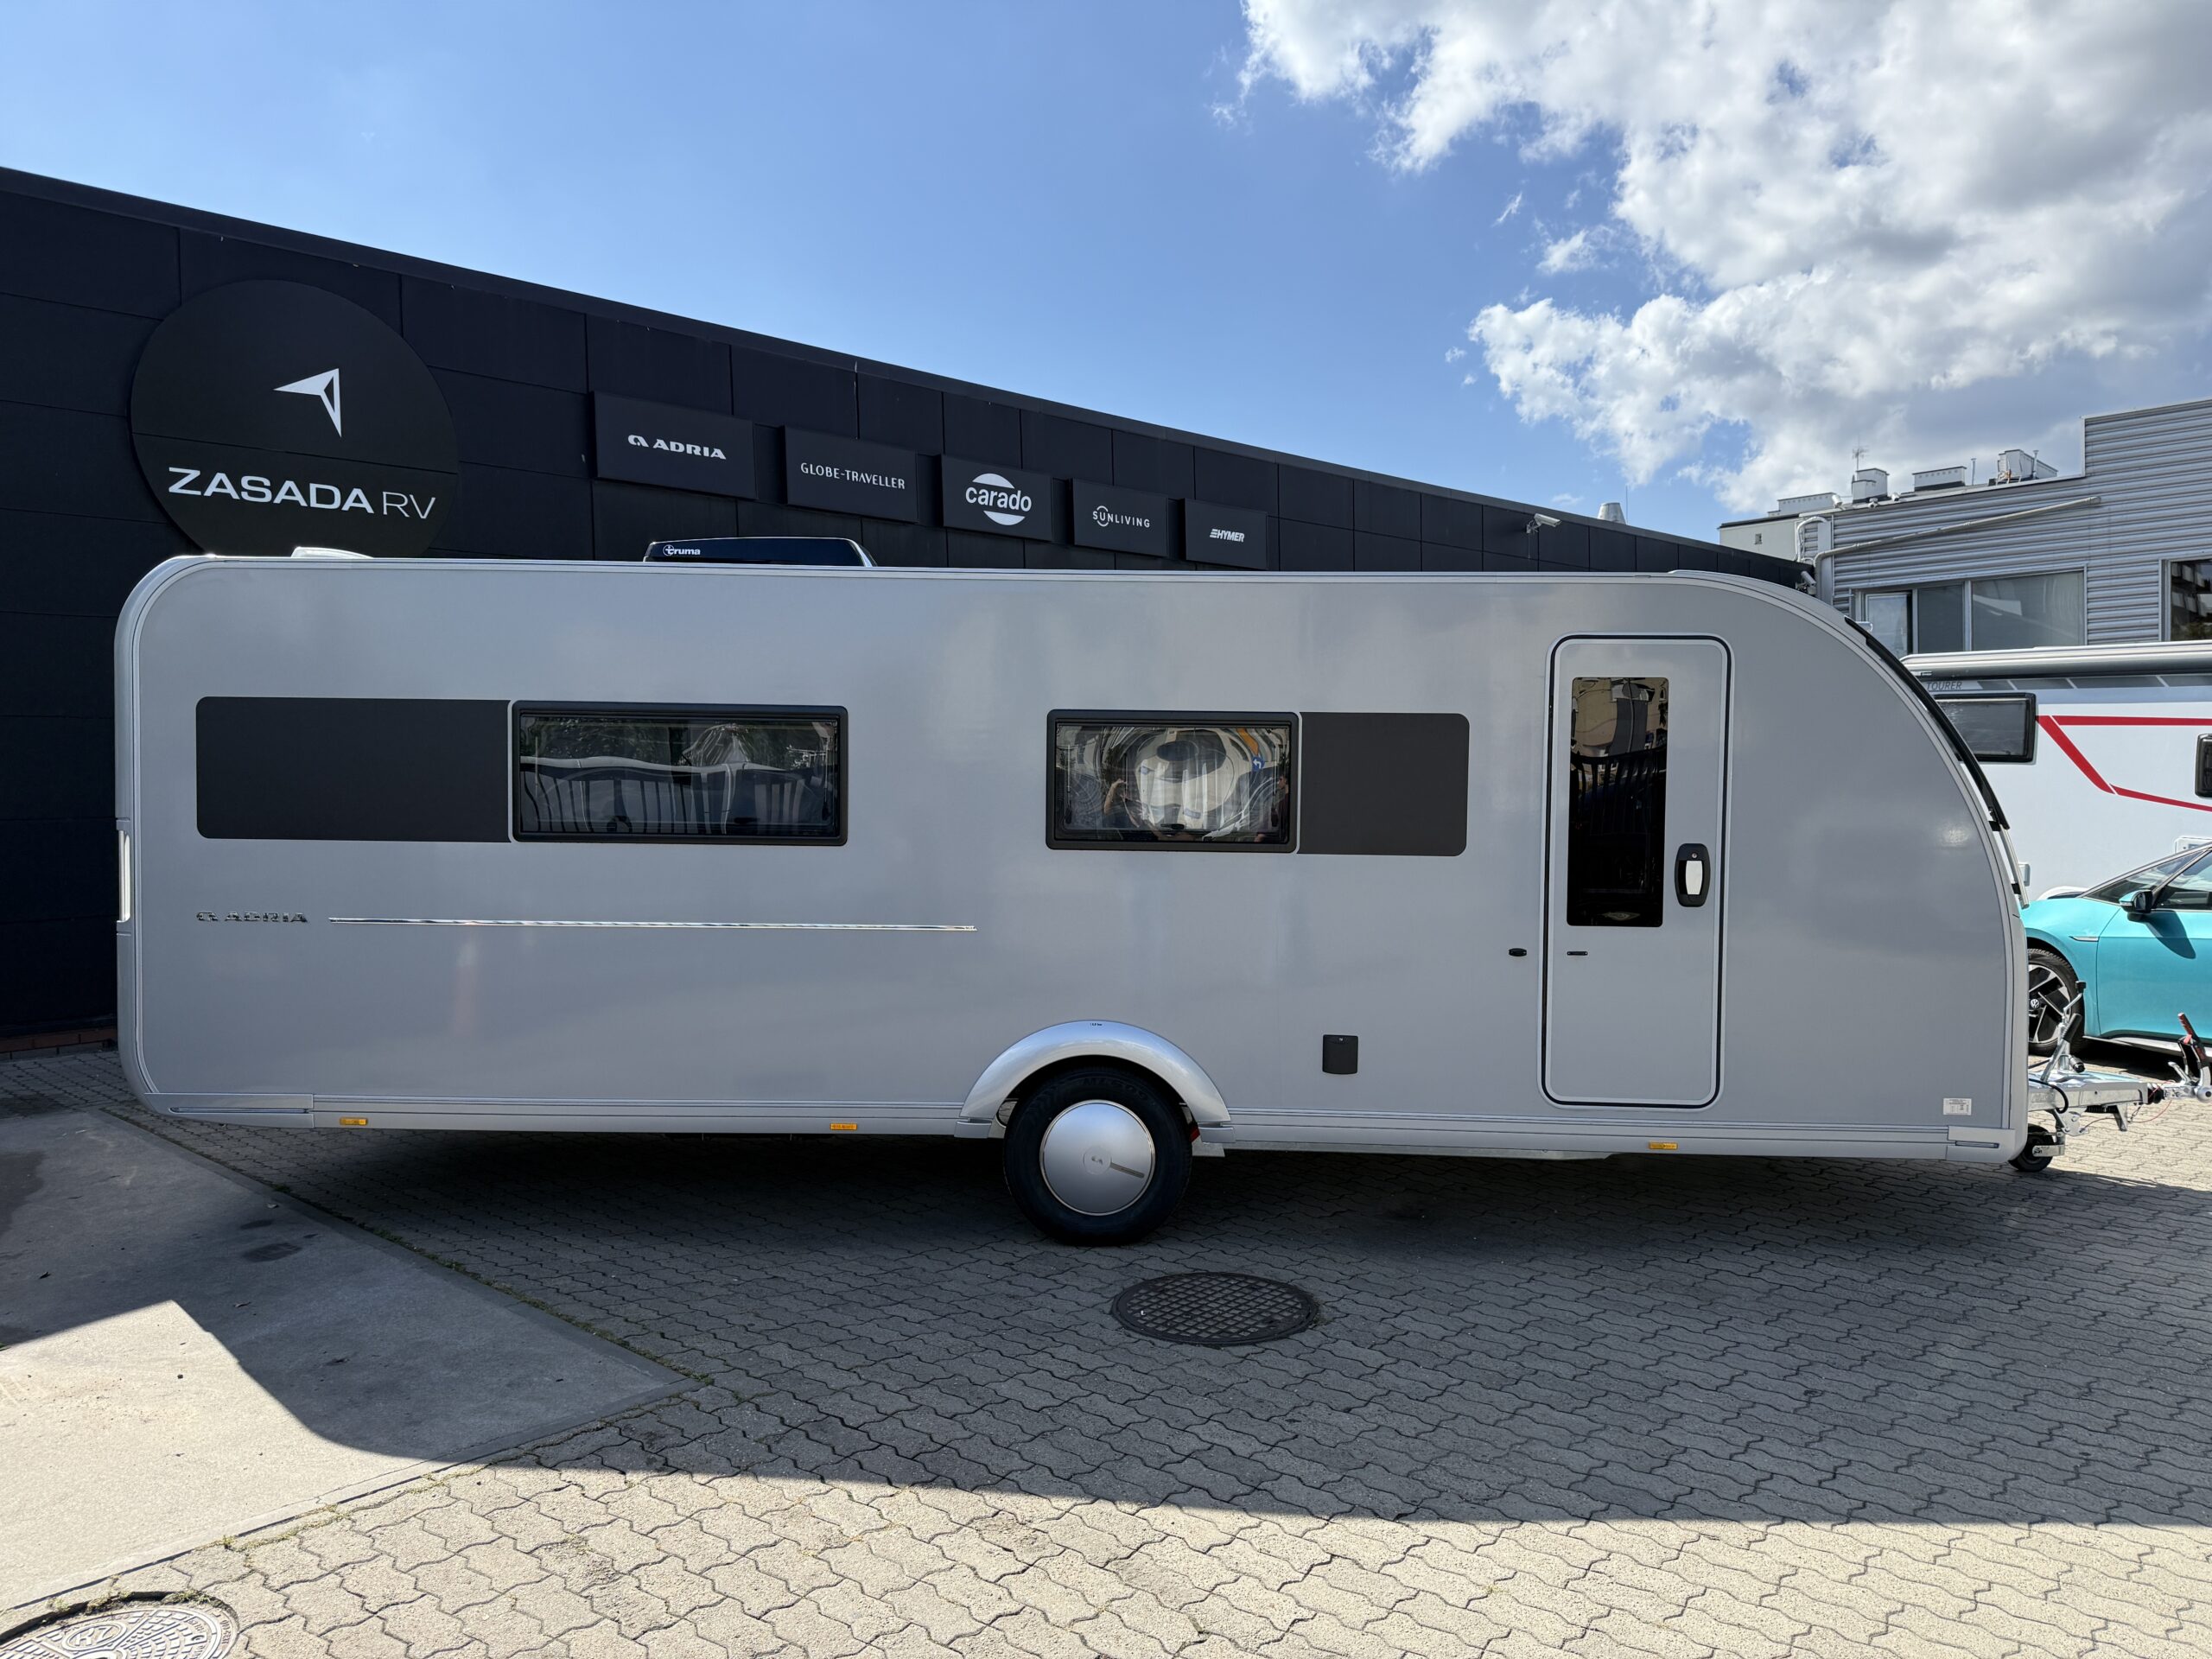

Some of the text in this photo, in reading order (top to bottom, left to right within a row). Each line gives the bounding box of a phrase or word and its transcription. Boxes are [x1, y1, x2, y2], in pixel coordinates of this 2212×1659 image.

[652, 438, 727, 460] ADRIA
[800, 462, 906, 490] GLOBE-TRAVELLER
[168, 467, 436, 519] ZASADA RV
[965, 486, 1033, 512] carado
[1092, 509, 1151, 529] SUNLIVING
[1217, 529, 1245, 543] HYMER
[664, 545, 702, 556] truma
[1926, 681, 1962, 690] TOURER
[225, 912, 308, 923] ADRIA
